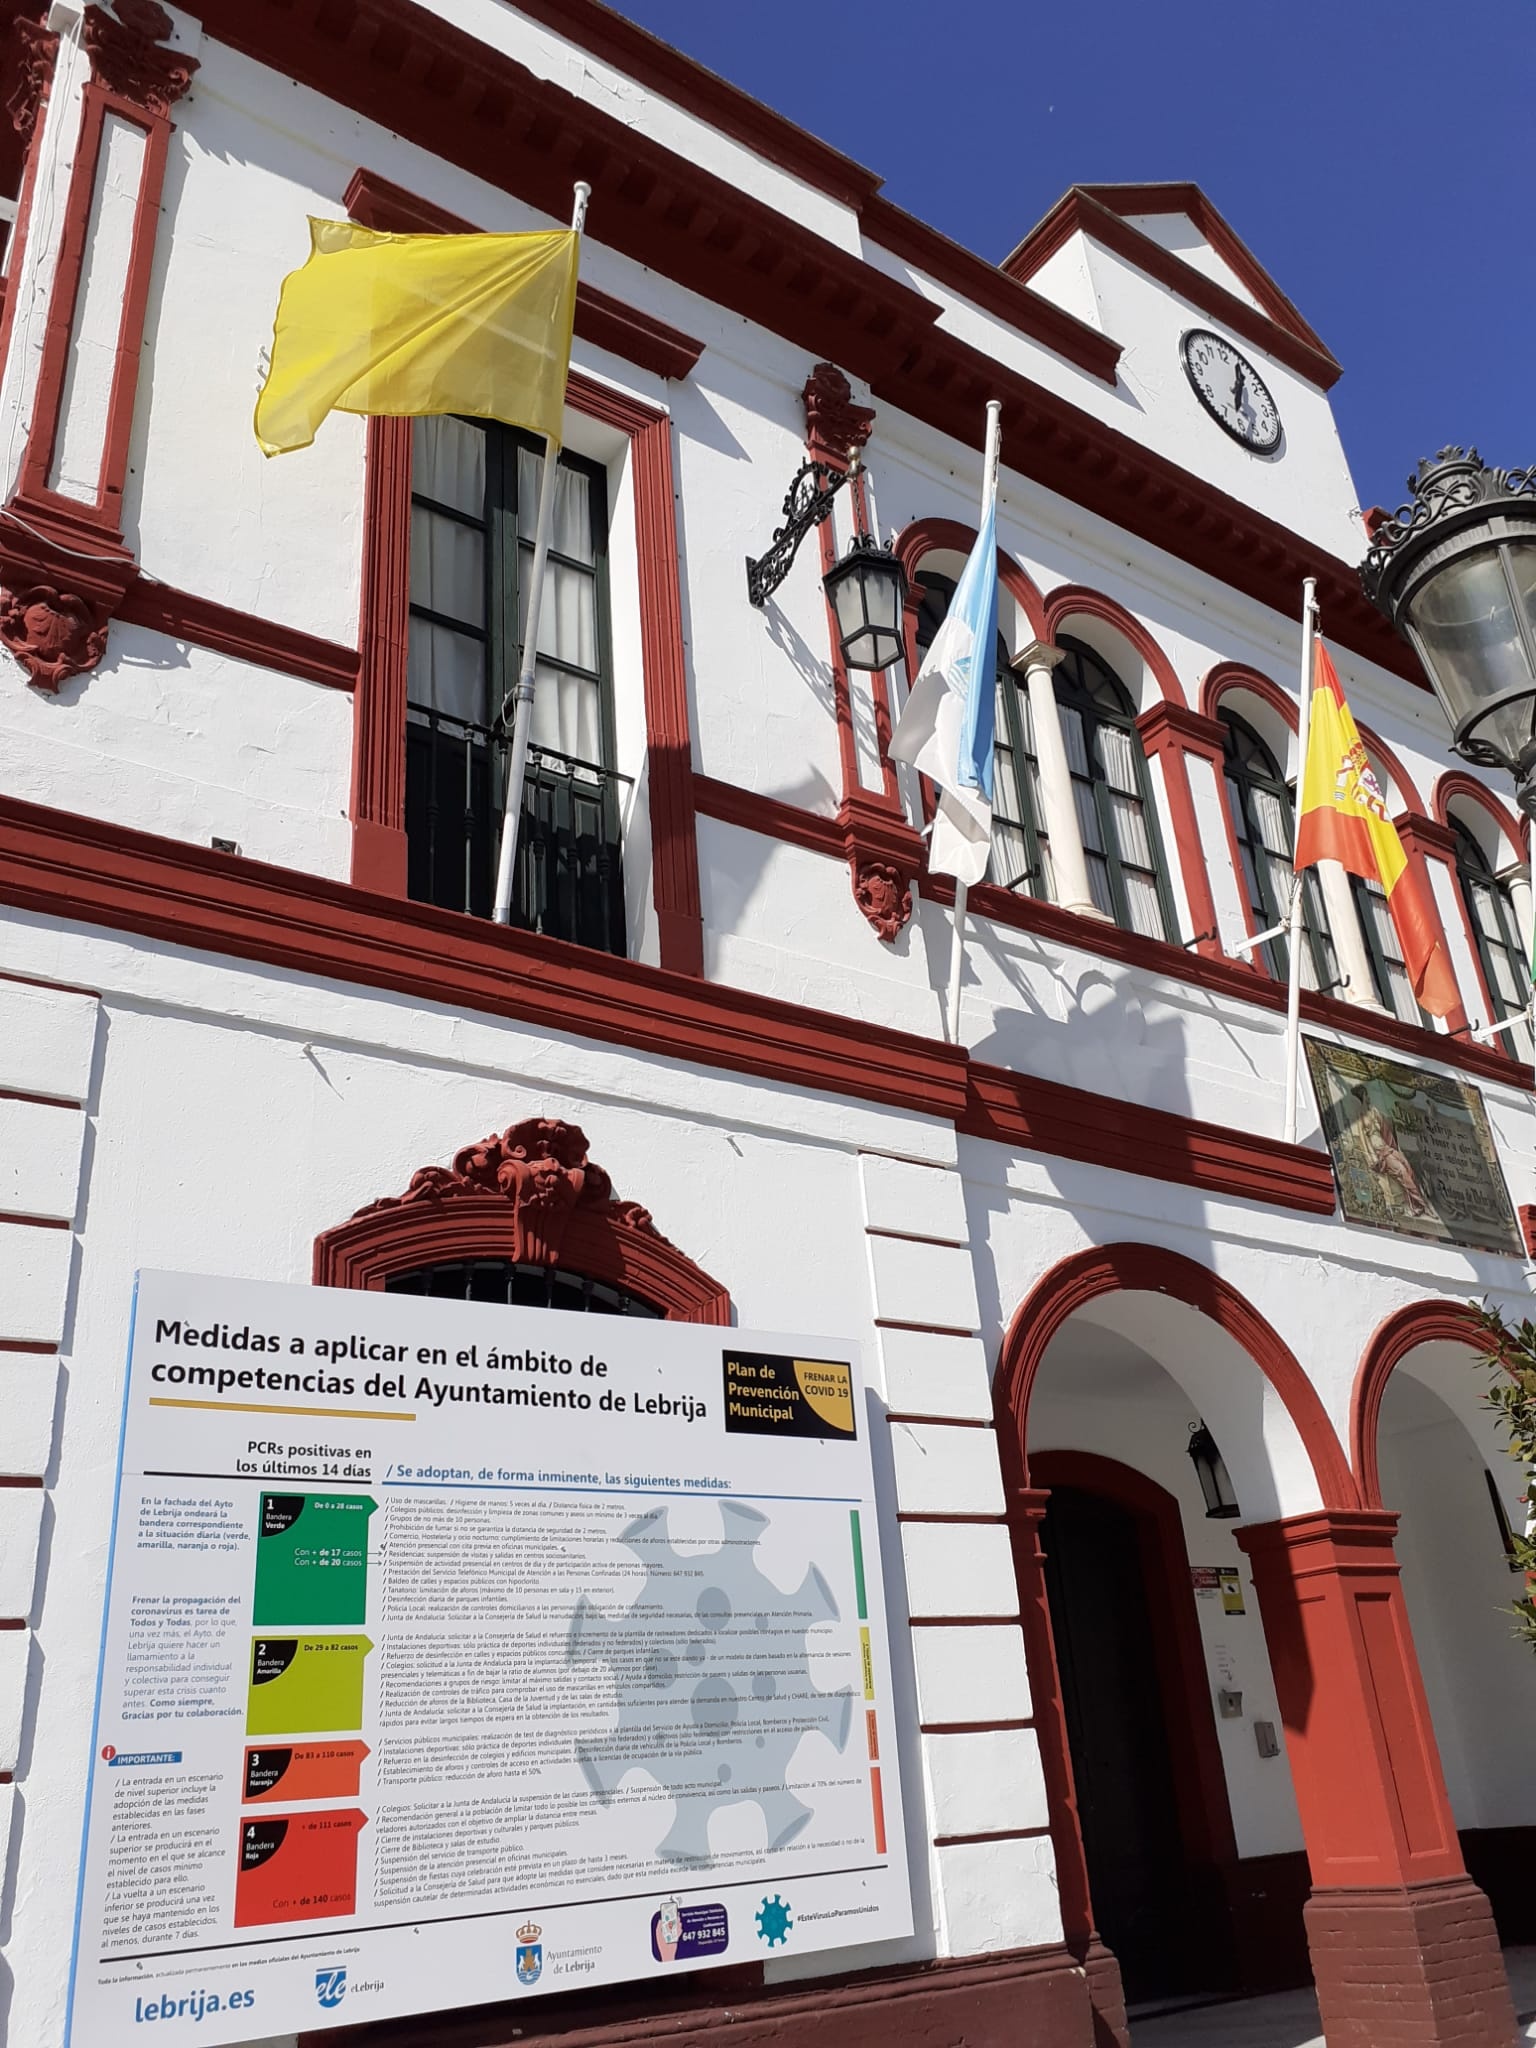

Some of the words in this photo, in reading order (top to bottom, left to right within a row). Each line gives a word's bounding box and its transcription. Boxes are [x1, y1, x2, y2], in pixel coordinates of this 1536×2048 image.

[1196, 349, 1208, 365] 10
[1218, 348, 1229, 364] 12
[155, 1320, 280, 1352] Medidas
[289, 1337, 304, 1354] a
[315, 1335, 408, 1363] aplicar
[417, 1349, 447, 1365] en
[456, 1346, 478, 1367] el
[486, 1348, 572, 1376] ámbito
[580, 1356, 607, 1378] de
[728, 1363, 757, 1377] Plan
[759, 1365, 775, 1379] de
[804, 1372, 836, 1383] FRENAR
[837, 1375, 847, 1384] LA
[151, 1363, 355, 1394] competencias
[364, 1373, 406, 1398] del
[414, 1377, 591, 1411] Ayuntamiento
[599, 1389, 626, 1412] de
[635, 1392, 707, 1423] Lebrija
[728, 1383, 799, 1400] Prevención
[805, 1385, 835, 1397] COVID
[837, 1387, 848, 1398] 19
[730, 1405, 793, 1422] Municipal
[248, 1441, 284, 1455] PCRs
[289, 1445, 351, 1460] positivas
[355, 1449, 371, 1458] en
[236, 1460, 258, 1473] los
[263, 1460, 317, 1475] últimos
[322, 1464, 339, 1476] 14
[343, 1464, 371, 1477] días
[397, 1465, 412, 1477] Se
[417, 1465, 473, 1480] adoptan,
[478, 1468, 493, 1480] de
[498, 1469, 534, 1482] forma
[539, 1470, 601, 1486] inminente,
[605, 1472, 621, 1485] las
[624, 1474, 681, 1488] siguientes
[684, 1475, 731, 1488] medidas:
[141, 1497, 151, 1505] En
[164, 1498, 197, 1506] fachada
[214, 1500, 233, 1508] Ayto
[267, 1499, 274, 1509] 1
[153, 1508, 182, 1518] Lebrija
[184, 1508, 217, 1517] ondeará
[266, 1513, 292, 1521] Bandera
[139, 1519, 173, 1527] bandera
[176, 1520, 243, 1530] correspondiente
[145, 1530, 153, 1538] la
[156, 1530, 194, 1539] situación
[197, 1531, 220, 1539] diaria
[223, 1531, 250, 1540] (verde,
[177, 1542, 209, 1551] naranja
[295, 1558, 310, 1566] Con
[320, 1558, 329, 1566] de
[133, 1596, 159, 1604] Frenar
[163, 1596, 170, 1604] la
[173, 1596, 225, 1606] propagación
[228, 1596, 241, 1604] del
[131, 1607, 182, 1615] coronavirus
[220, 1607, 230, 1615] de
[258, 1645, 265, 1655] 2
[122, 1710, 154, 1720] Gracias
[157, 1711, 172, 1720] por
[175, 1709, 184, 1718] tu
[186, 1708, 244, 1717] colaboración.
[252, 1755, 259, 1766] 3
[122, 1778, 130, 1786] La
[133, 1776, 162, 1785] entrada
[188, 1773, 223, 1782] escenario
[251, 1769, 279, 1778] Bandera
[250, 1778, 272, 1787] Naranja
[248, 1826, 255, 1838] 4
[246, 1842, 274, 1850] Bandera
[246, 1852, 259, 1860] Roja
[273, 1900, 289, 1908] Con
[300, 1896, 311, 1905] de
[313, 1895, 328, 1904] 140
[798, 1905, 879, 1922] #EsteVirusLoParamosUnidos
[683, 1930, 696, 1941] 647
[697, 1928, 711, 1939] 932
[712, 1928, 725, 1937] 845
[546, 1945, 602, 1961] Ayuntamiento
[553, 1964, 563, 1974] de
[566, 1961, 595, 1973] Lebrija
[350, 1980, 384, 1992] eLebrija
[135, 1989, 255, 2023] lebrija.es
